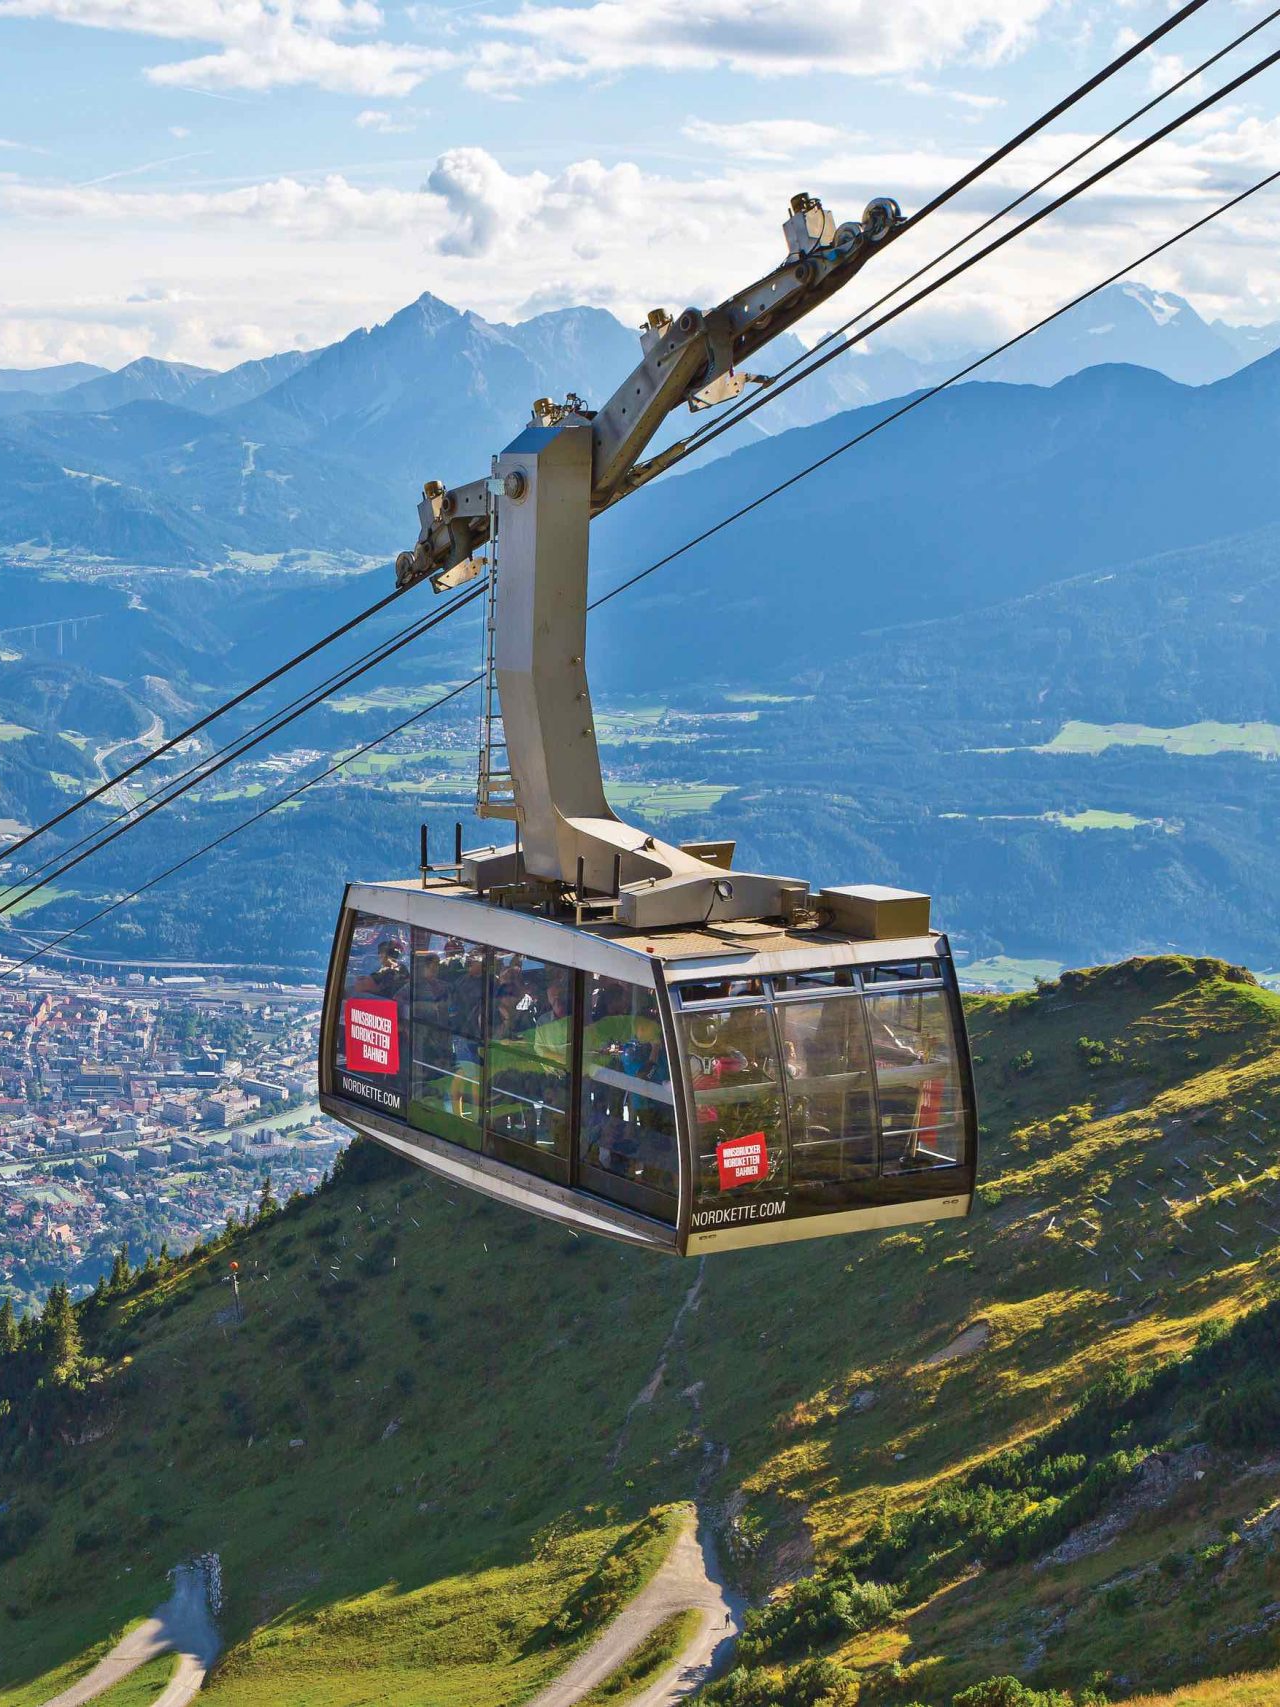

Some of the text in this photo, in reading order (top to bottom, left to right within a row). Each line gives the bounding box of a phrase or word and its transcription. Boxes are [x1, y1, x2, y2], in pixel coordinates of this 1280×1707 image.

[351, 1008, 391, 1034] INNSBRUCKER
[351, 1024, 390, 1050] NORDKETTEN
[363, 1045, 387, 1065] BAHNEN
[343, 1077, 400, 1109] NORDKETTE.COM
[723, 1145, 760, 1158] INNSBRUCKER
[724, 1155, 760, 1169] NORDKETTEN
[736, 1166, 758, 1177] BAHNEN
[691, 1201, 786, 1227] NORDKETTE.COM
